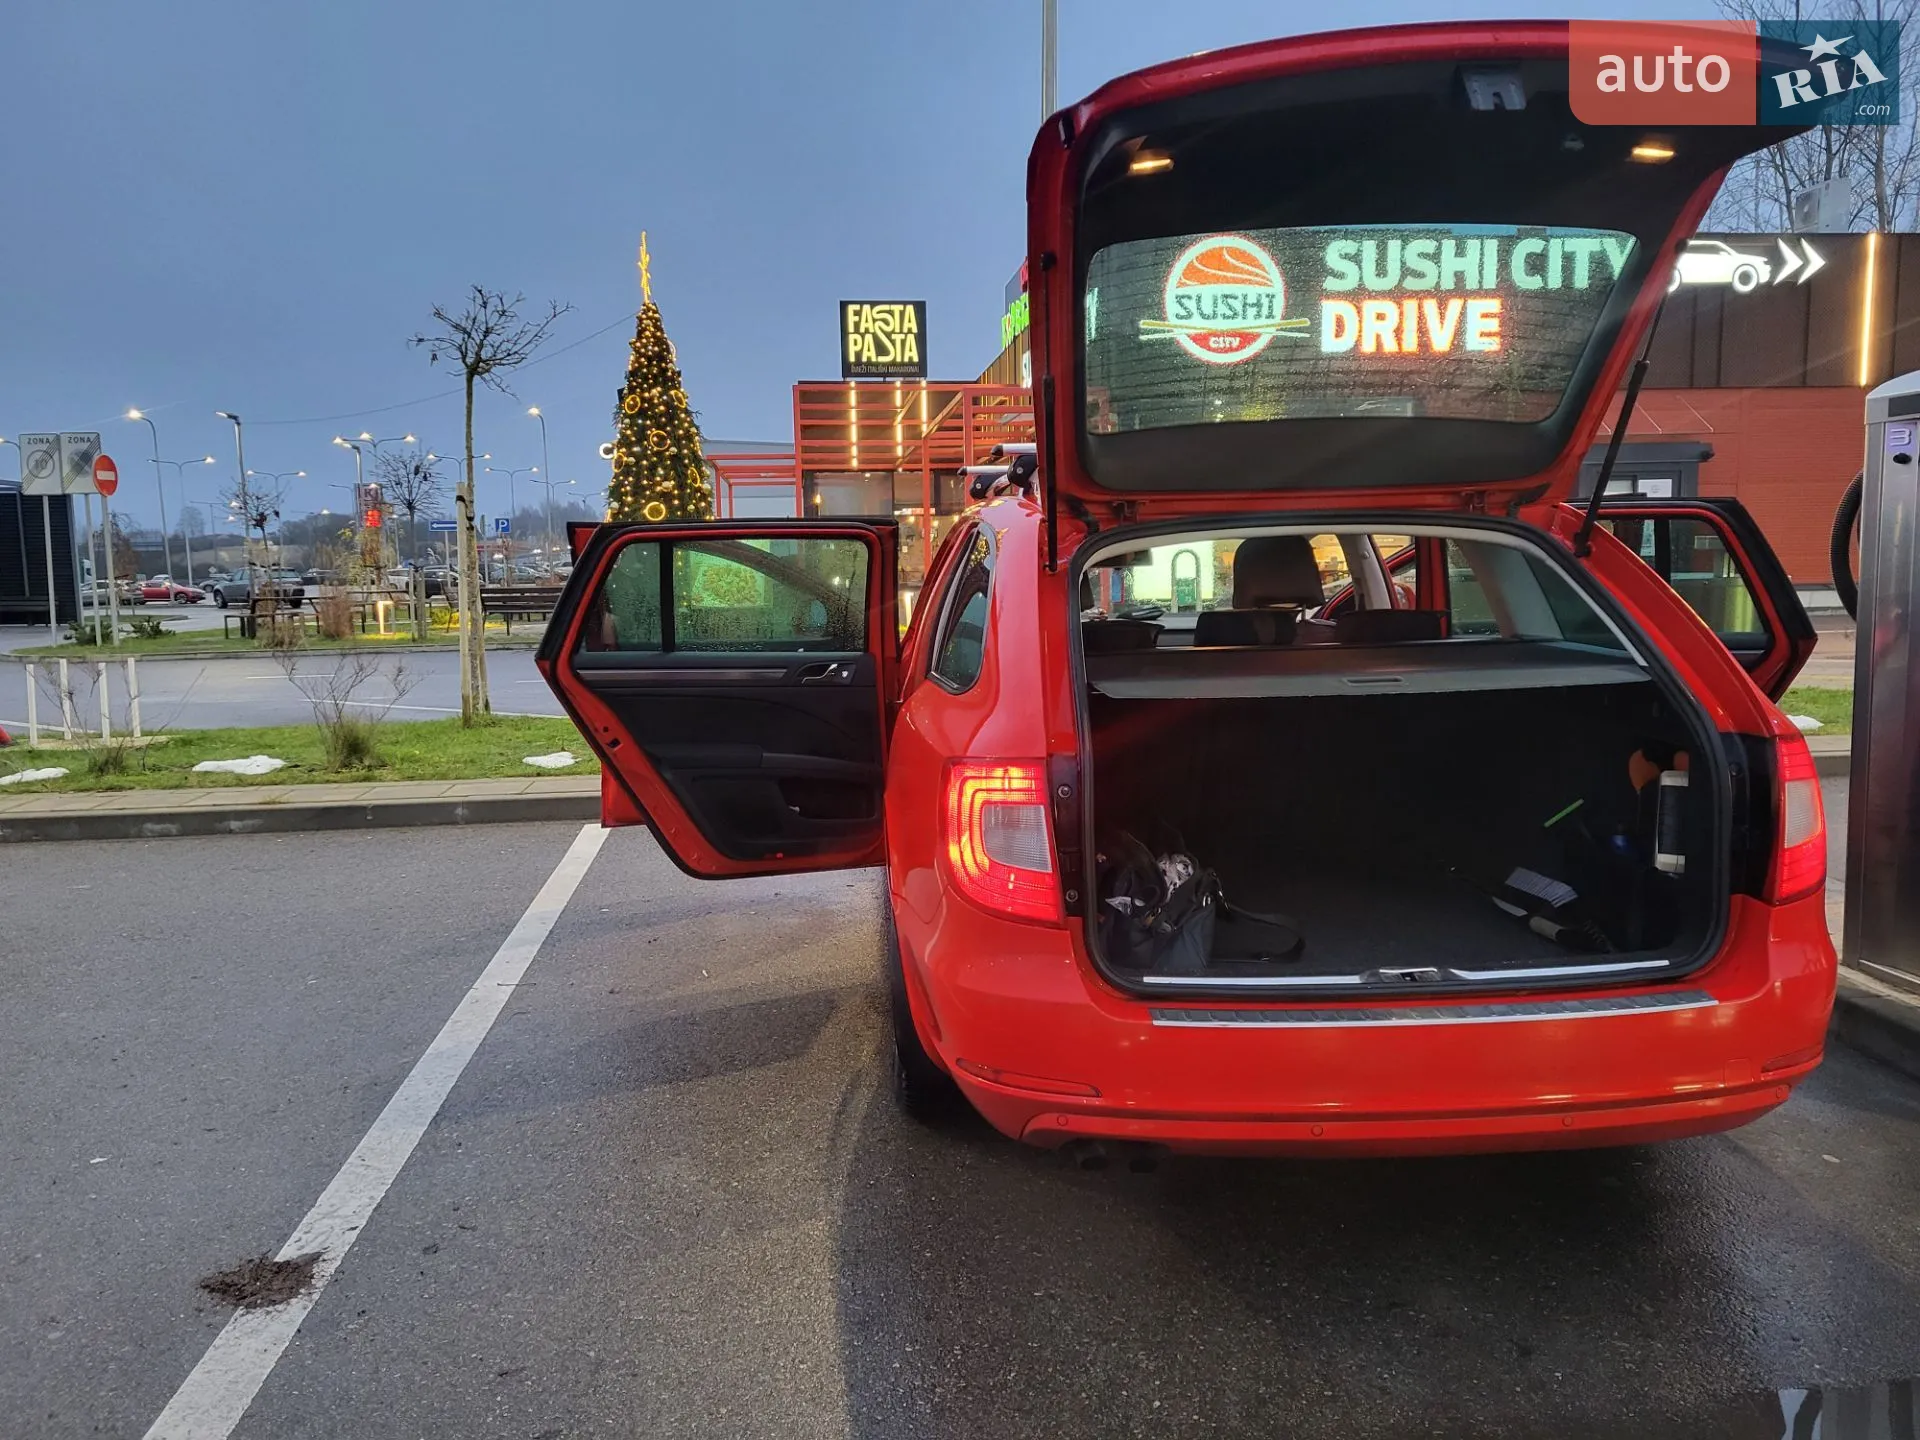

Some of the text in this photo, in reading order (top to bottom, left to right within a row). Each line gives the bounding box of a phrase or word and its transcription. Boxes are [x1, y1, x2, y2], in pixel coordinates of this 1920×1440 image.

[1322, 237, 1634, 291] SUSHI CITY
[847, 304, 918, 333] FASTA
[1174, 292, 1276, 320] SUSHI
[1320, 298, 1502, 353] DRIVE
[848, 333, 919, 362] PASTA
[1208, 336, 1241, 348] CITY
[27, 437, 51, 445] ZONA
[499, 519, 507, 531] P
